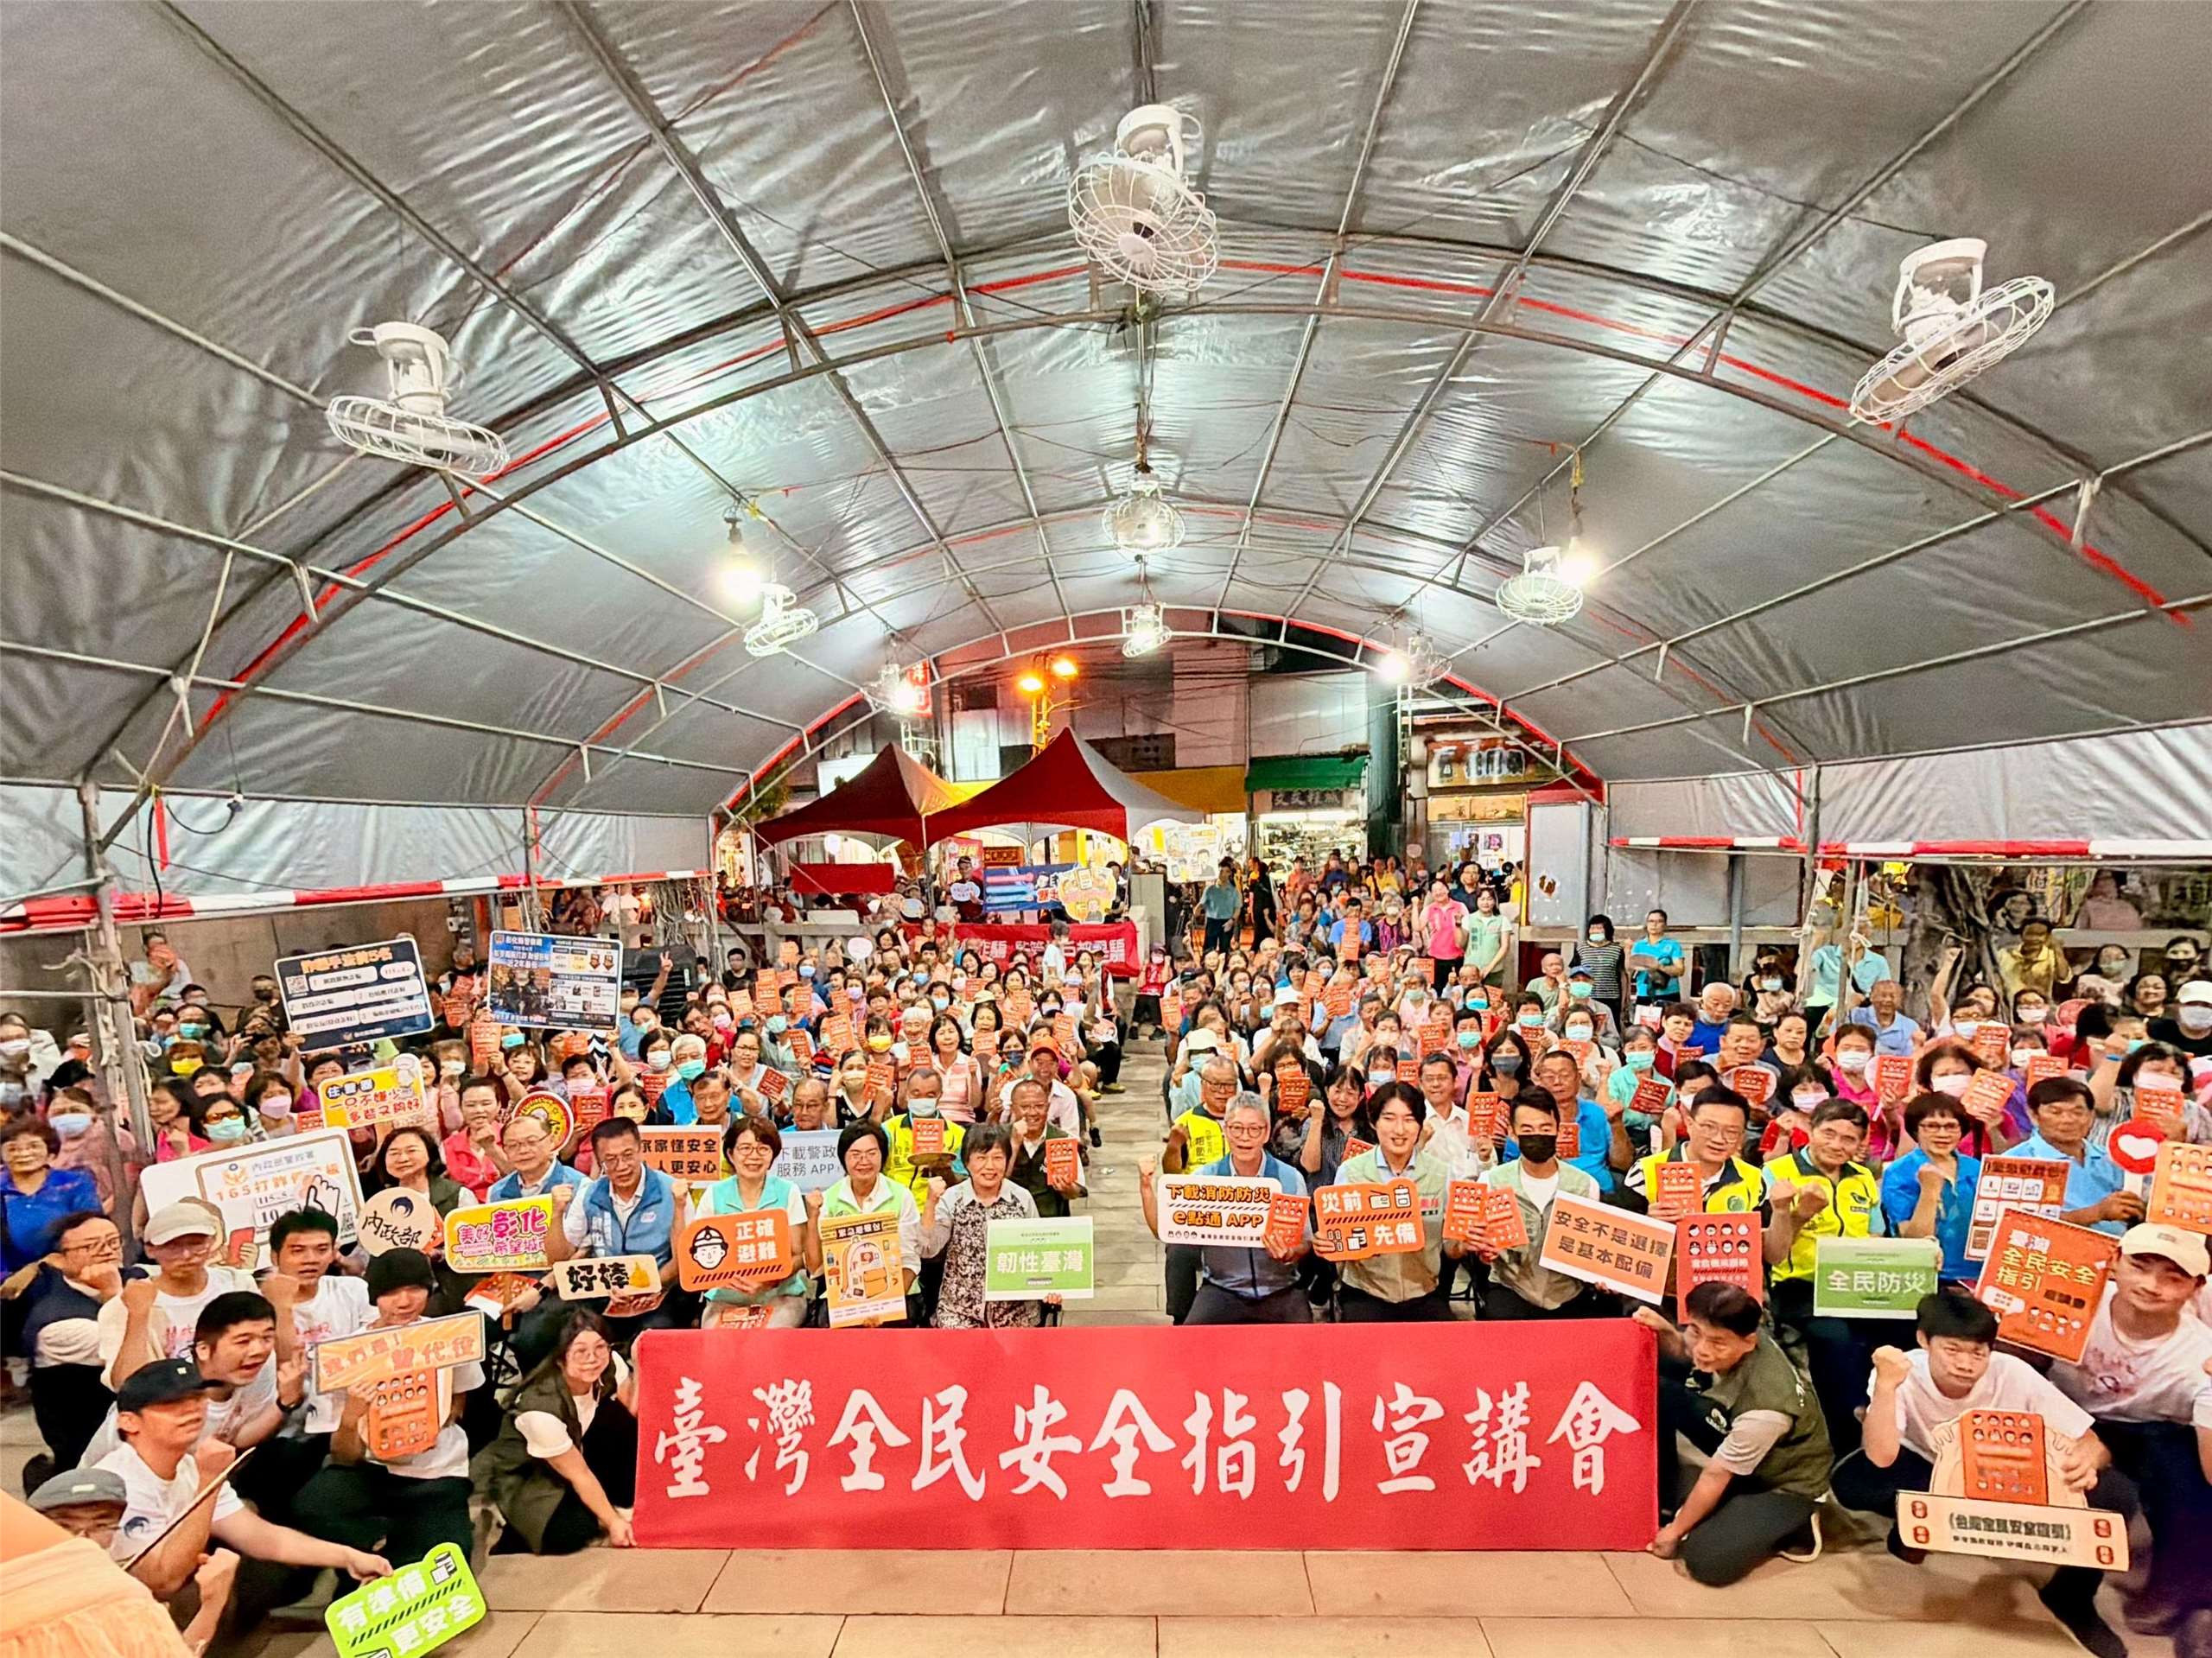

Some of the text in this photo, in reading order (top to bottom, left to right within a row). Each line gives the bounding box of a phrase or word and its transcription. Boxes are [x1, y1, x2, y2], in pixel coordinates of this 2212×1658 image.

[780, 1145, 837, 1161] 下載警政
[777, 1162, 835, 1178] 服務 APP
[1166, 1184, 1272, 1204] 下載消防防災
[1321, 1191, 1362, 1215] 災前
[361, 1210, 423, 1248] 內政部
[459, 1206, 549, 1244] 美好 彰化
[735, 1218, 775, 1241] 正確
[1173, 1210, 1264, 1228] e點通 APP
[1373, 1223, 1417, 1246] 先備
[1554, 1210, 1669, 1258] 安全不是選擇
[738, 1241, 778, 1263] 避難
[996, 1249, 1084, 1274] 韌性臺灣
[1558, 1236, 1654, 1280] 是基本配備
[566, 1262, 630, 1293] 好棒
[1995, 1266, 2042, 1293] 指引
[2000, 1247, 2097, 1287] 全民安全
[1827, 1269, 1927, 1294] 全民防災
[652, 1376, 1643, 1503] 臺灣全民安全指引宣講會
[390, 1595, 477, 1655] 更安全
